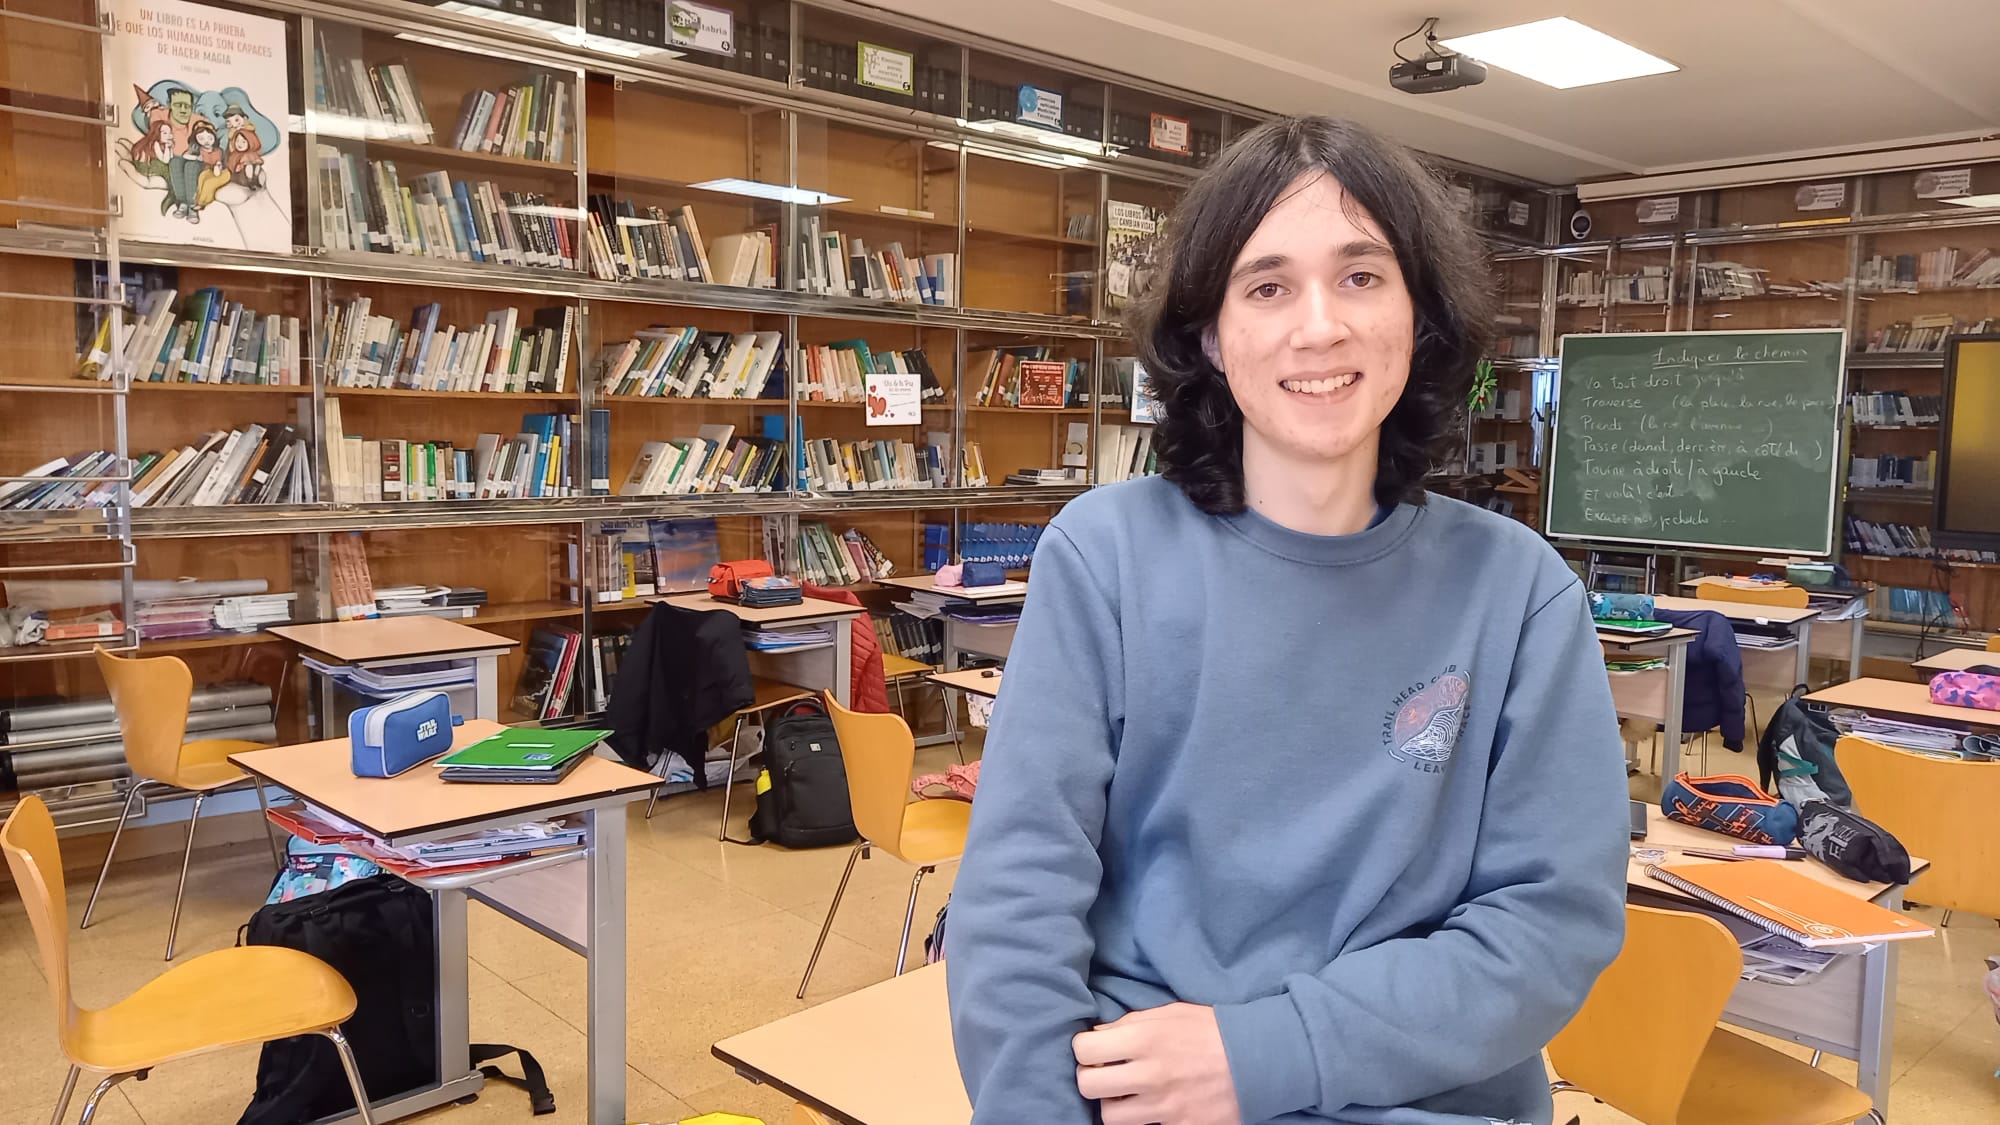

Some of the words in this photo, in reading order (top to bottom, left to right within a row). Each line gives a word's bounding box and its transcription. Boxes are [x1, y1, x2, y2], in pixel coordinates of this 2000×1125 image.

[140, 8, 153, 22] UN
[156, 12, 183, 27] LIBRO
[186, 16, 196, 30] ES
[199, 19, 210, 32] LA
[213, 21, 246, 38] PRUEBA
[125, 22, 144, 36] QUE
[147, 25, 164, 39] LOS
[167, 29, 213, 48] HUMANOS
[216, 38, 234, 51] SON
[237, 42, 273, 58] CAPACES
[157, 42, 169, 55] DE
[171, 45, 200, 60] HACER
[203, 51, 231, 65] MAGIA
[1114, 207, 1125, 217] LOS
[1125, 208, 1142, 220] LIBROS
[1120, 217, 1141, 229] CAMBIAN
[1141, 221, 1155, 232] VIDAS
[1652, 347, 1721, 370] Indiquer
[1736, 345, 1747, 361] le
[1755, 344, 1809, 360] chemin
[1586, 376, 1601, 390] Va
[1644, 373, 1682, 388] droit
[1581, 395, 1643, 409] Traverse
[1580, 414, 1622, 431] Prends
[1583, 435, 1618, 452] Passe
[1583, 458, 1625, 476] Tourne
[1713, 461, 1762, 486] gauche
[1382, 710, 1396, 746] TRAIL
[1392, 682, 1425, 707] HEAD
[1431, 664, 1457, 684] CB
[416, 726, 438, 742] WARS
[419, 719, 437, 733] STAR
[1413, 761, 1444, 774] LEA
